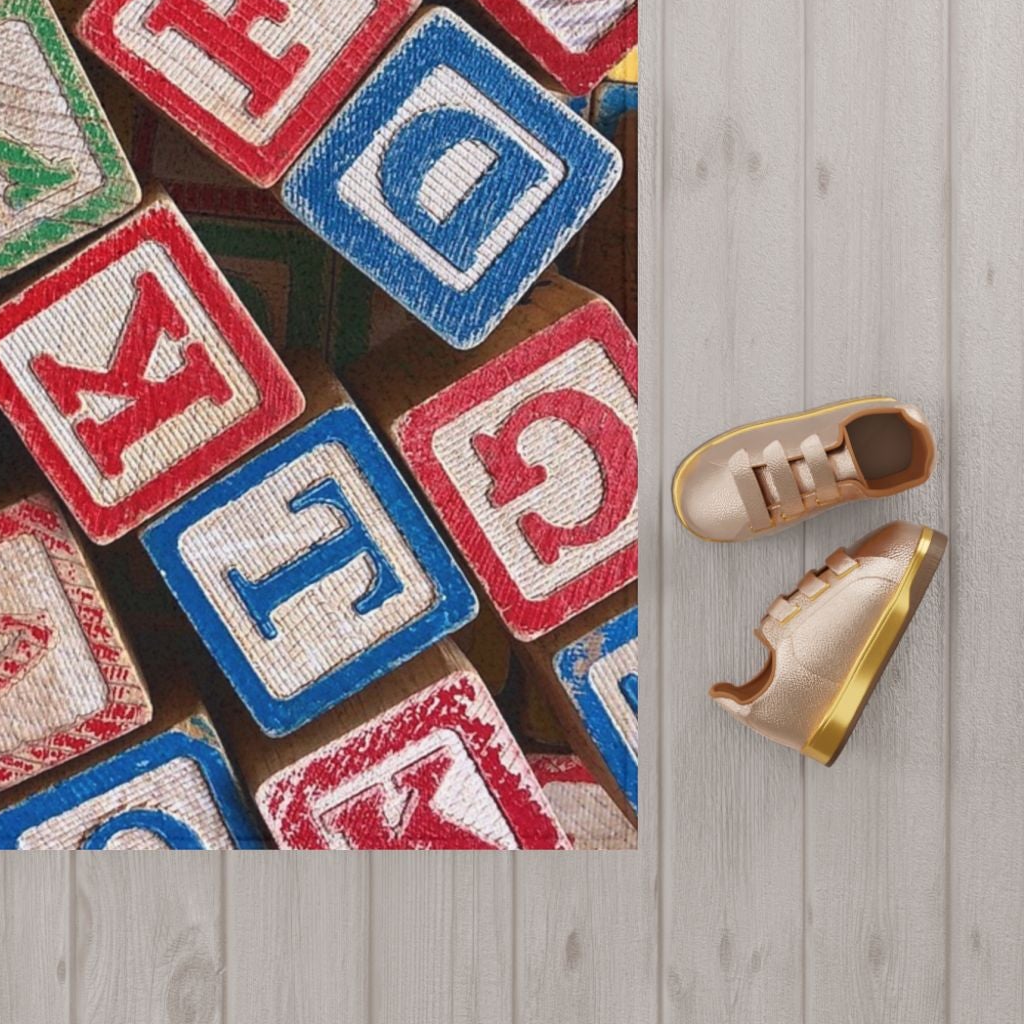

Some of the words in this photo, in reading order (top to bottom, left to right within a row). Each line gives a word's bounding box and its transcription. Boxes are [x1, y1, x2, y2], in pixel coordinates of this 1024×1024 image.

[377, 102, 552, 275] D
[28, 270, 236, 480] K
[226, 478, 405, 641] T
[470, 387, 637, 566] G
